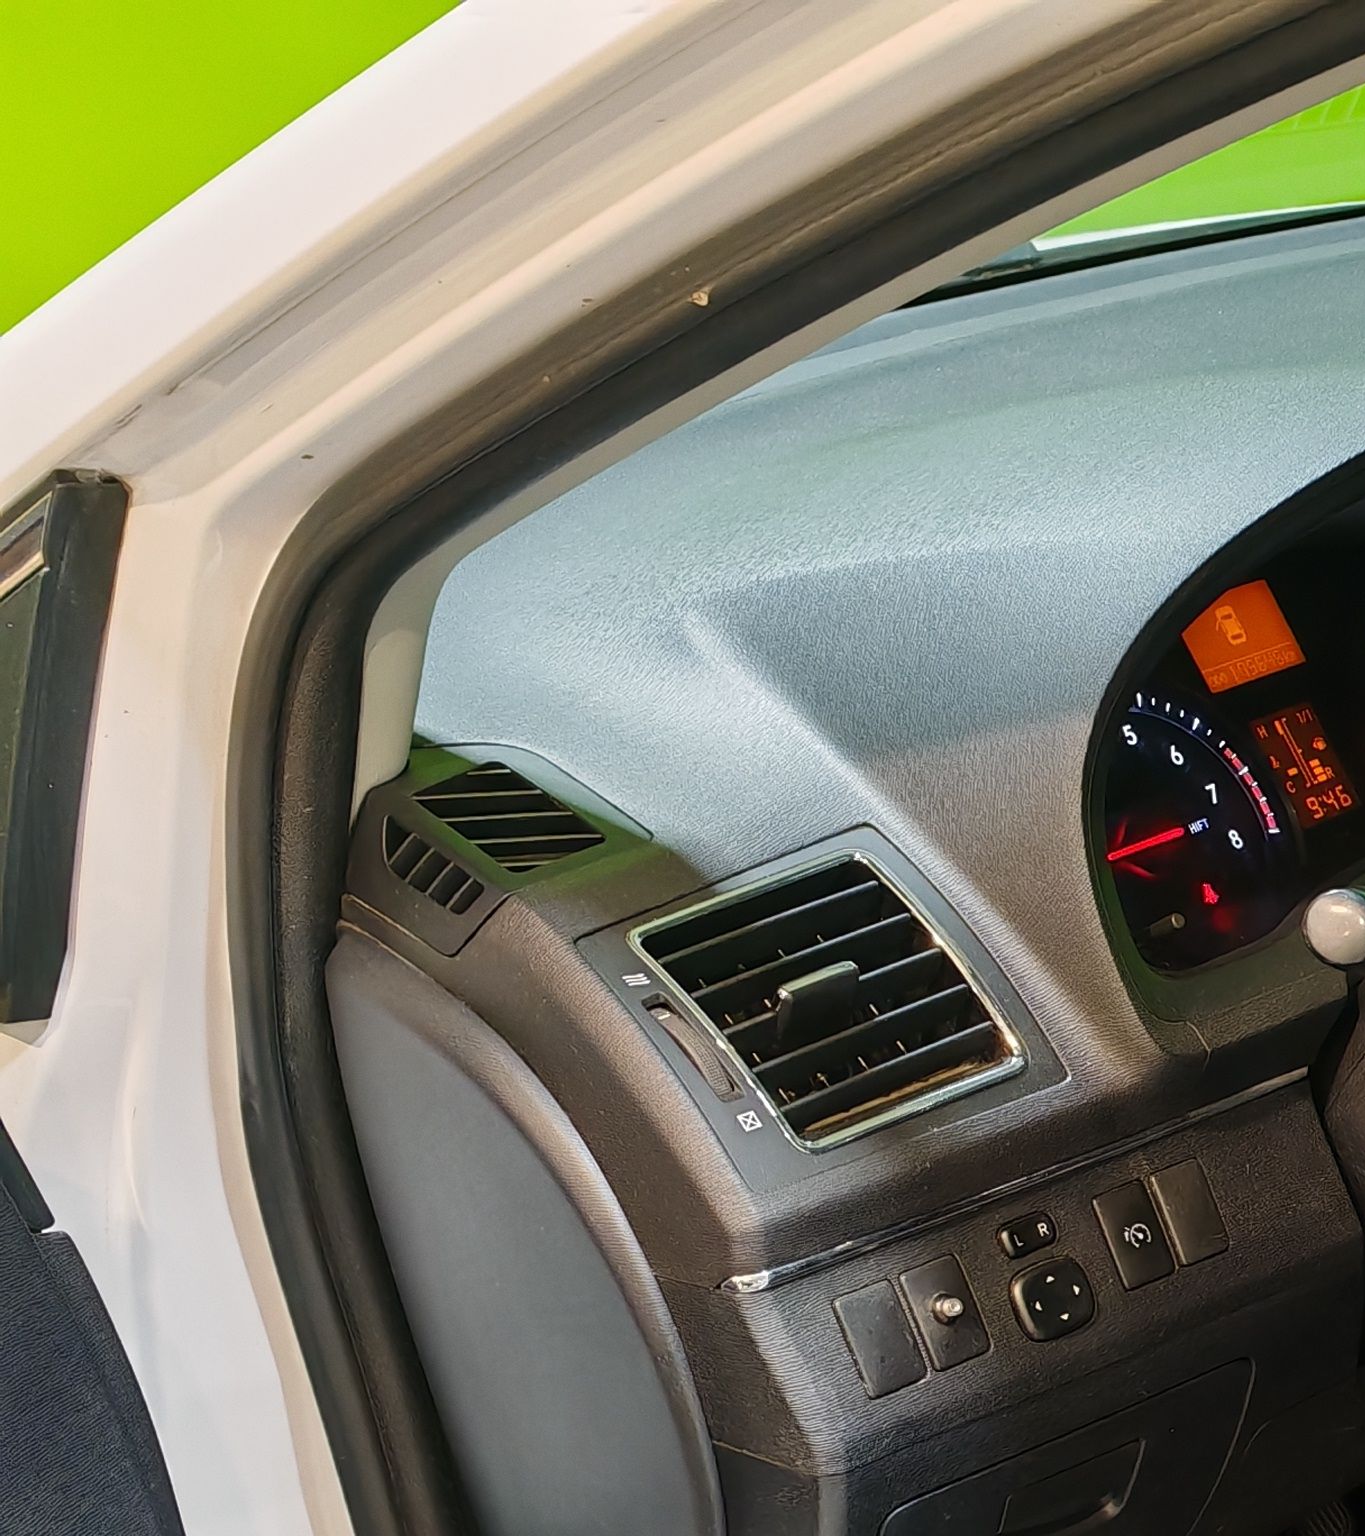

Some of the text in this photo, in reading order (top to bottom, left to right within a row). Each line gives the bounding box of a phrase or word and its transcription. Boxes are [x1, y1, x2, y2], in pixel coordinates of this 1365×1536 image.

[1122, 724, 1138, 746] 5
[1256, 724, 1269, 739] H
[1169, 744, 1185, 766] 6
[1204, 783, 1218, 805] 7
[1286, 780, 1297, 794] C
[1305, 784, 1353, 820] 9:46
[1187, 817, 1210, 835] HIFT
[1227, 829, 1244, 849] 8
[1036, 1221, 1050, 1237] R
[1013, 1233, 1025, 1247] L
